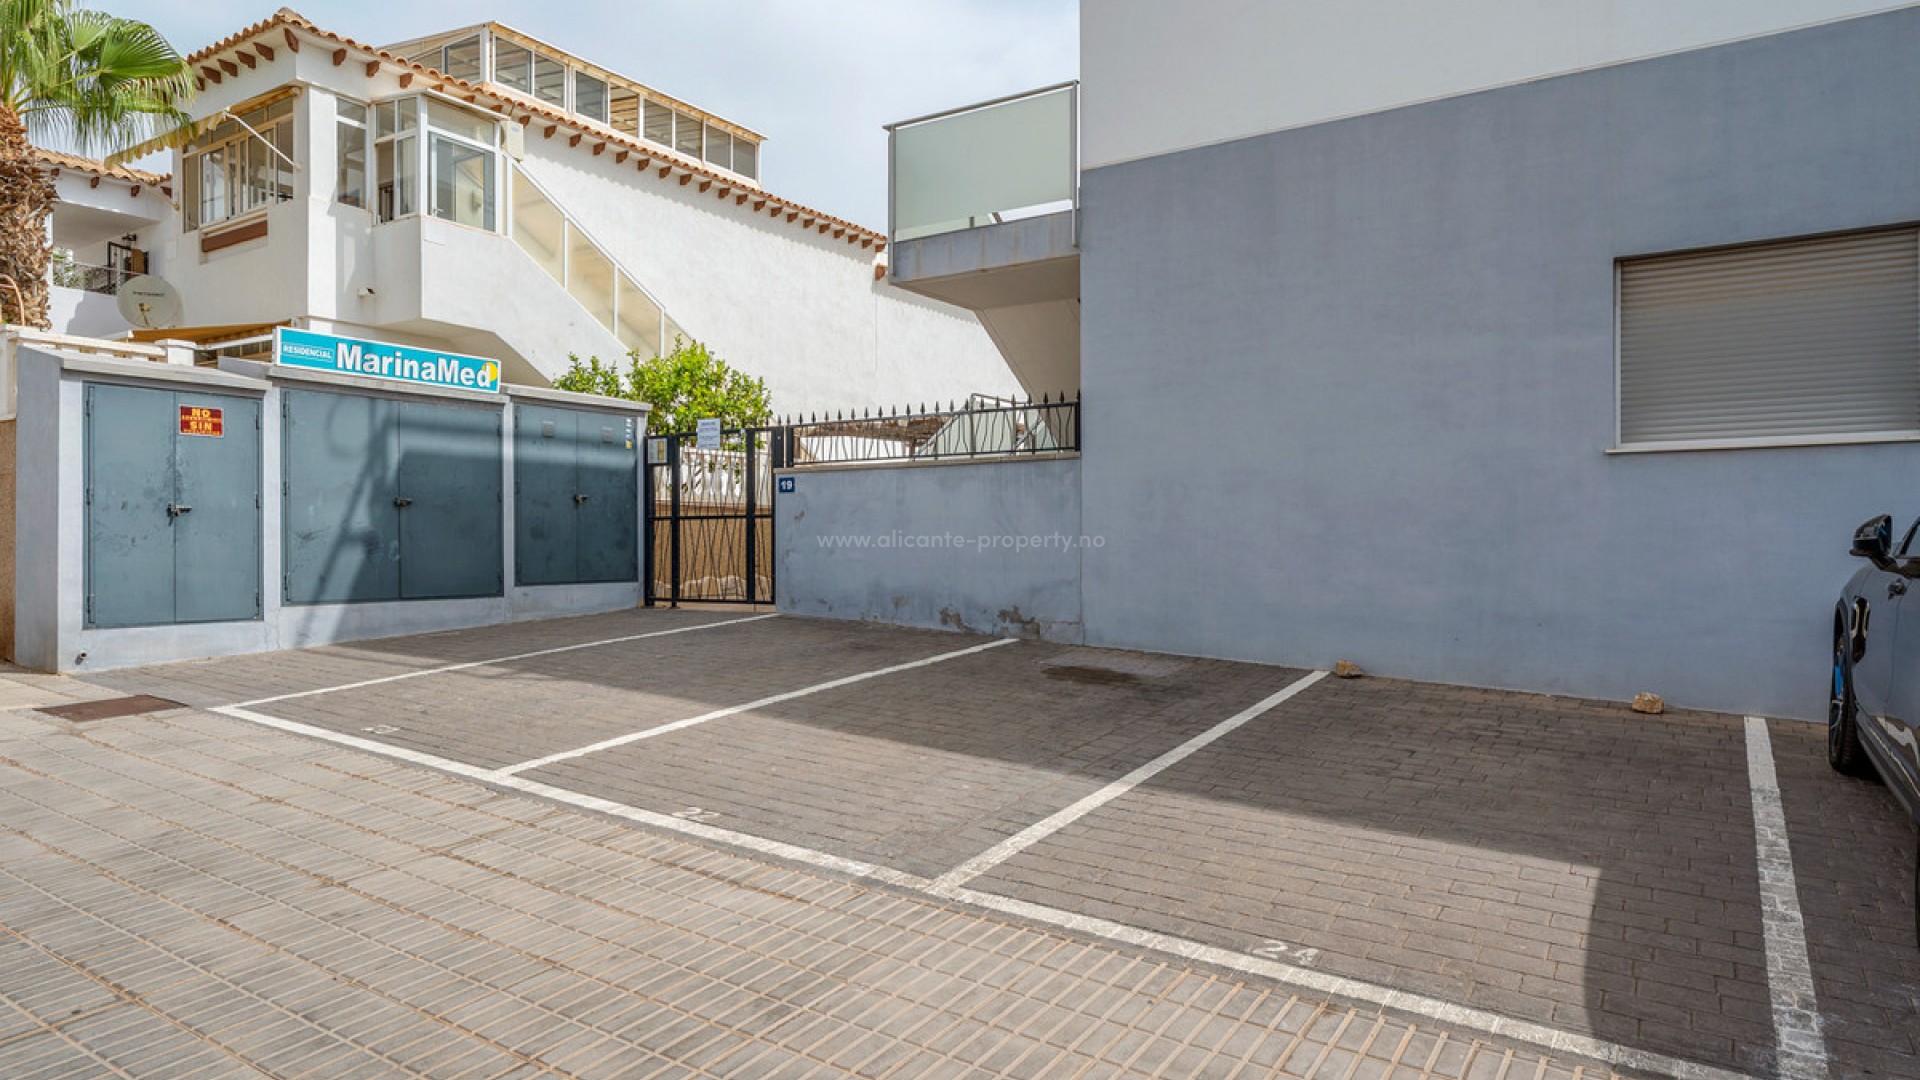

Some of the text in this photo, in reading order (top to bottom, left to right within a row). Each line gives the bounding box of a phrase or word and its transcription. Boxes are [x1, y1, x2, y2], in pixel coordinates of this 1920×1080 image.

[283, 342, 491, 387] RESIDENCIAL MarinaMed
[191, 408, 210, 418] NO
[780, 480, 793, 490] 19
